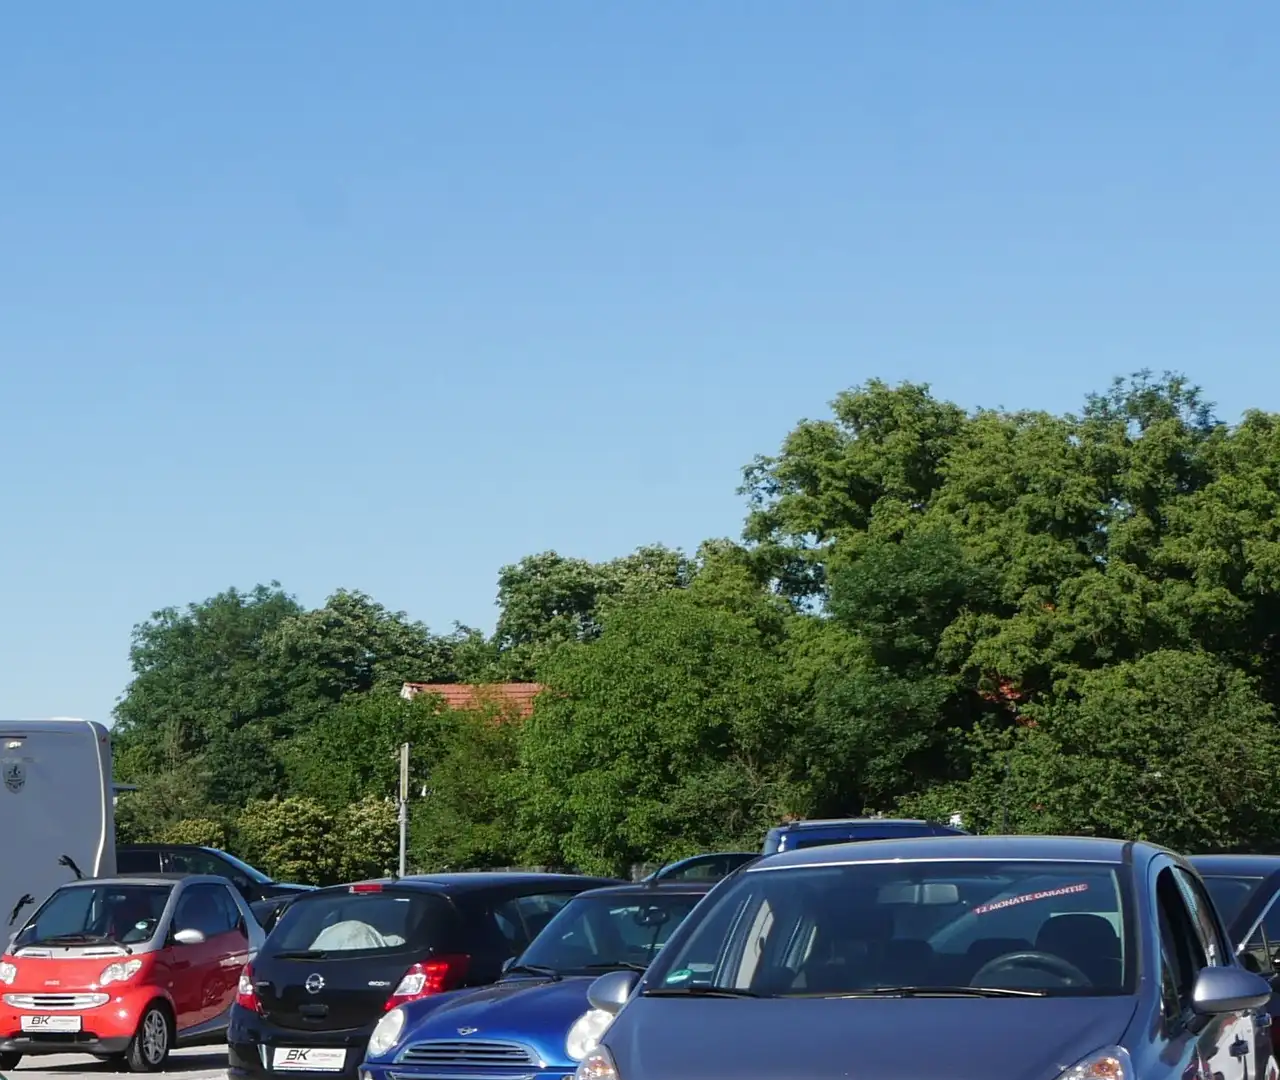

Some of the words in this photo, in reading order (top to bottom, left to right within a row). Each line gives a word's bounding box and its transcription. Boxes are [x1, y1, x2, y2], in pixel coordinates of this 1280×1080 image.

[989, 894, 1033, 911] MONATE
[31, 1016, 51, 1025] BK
[286, 1049, 311, 1060] BK
